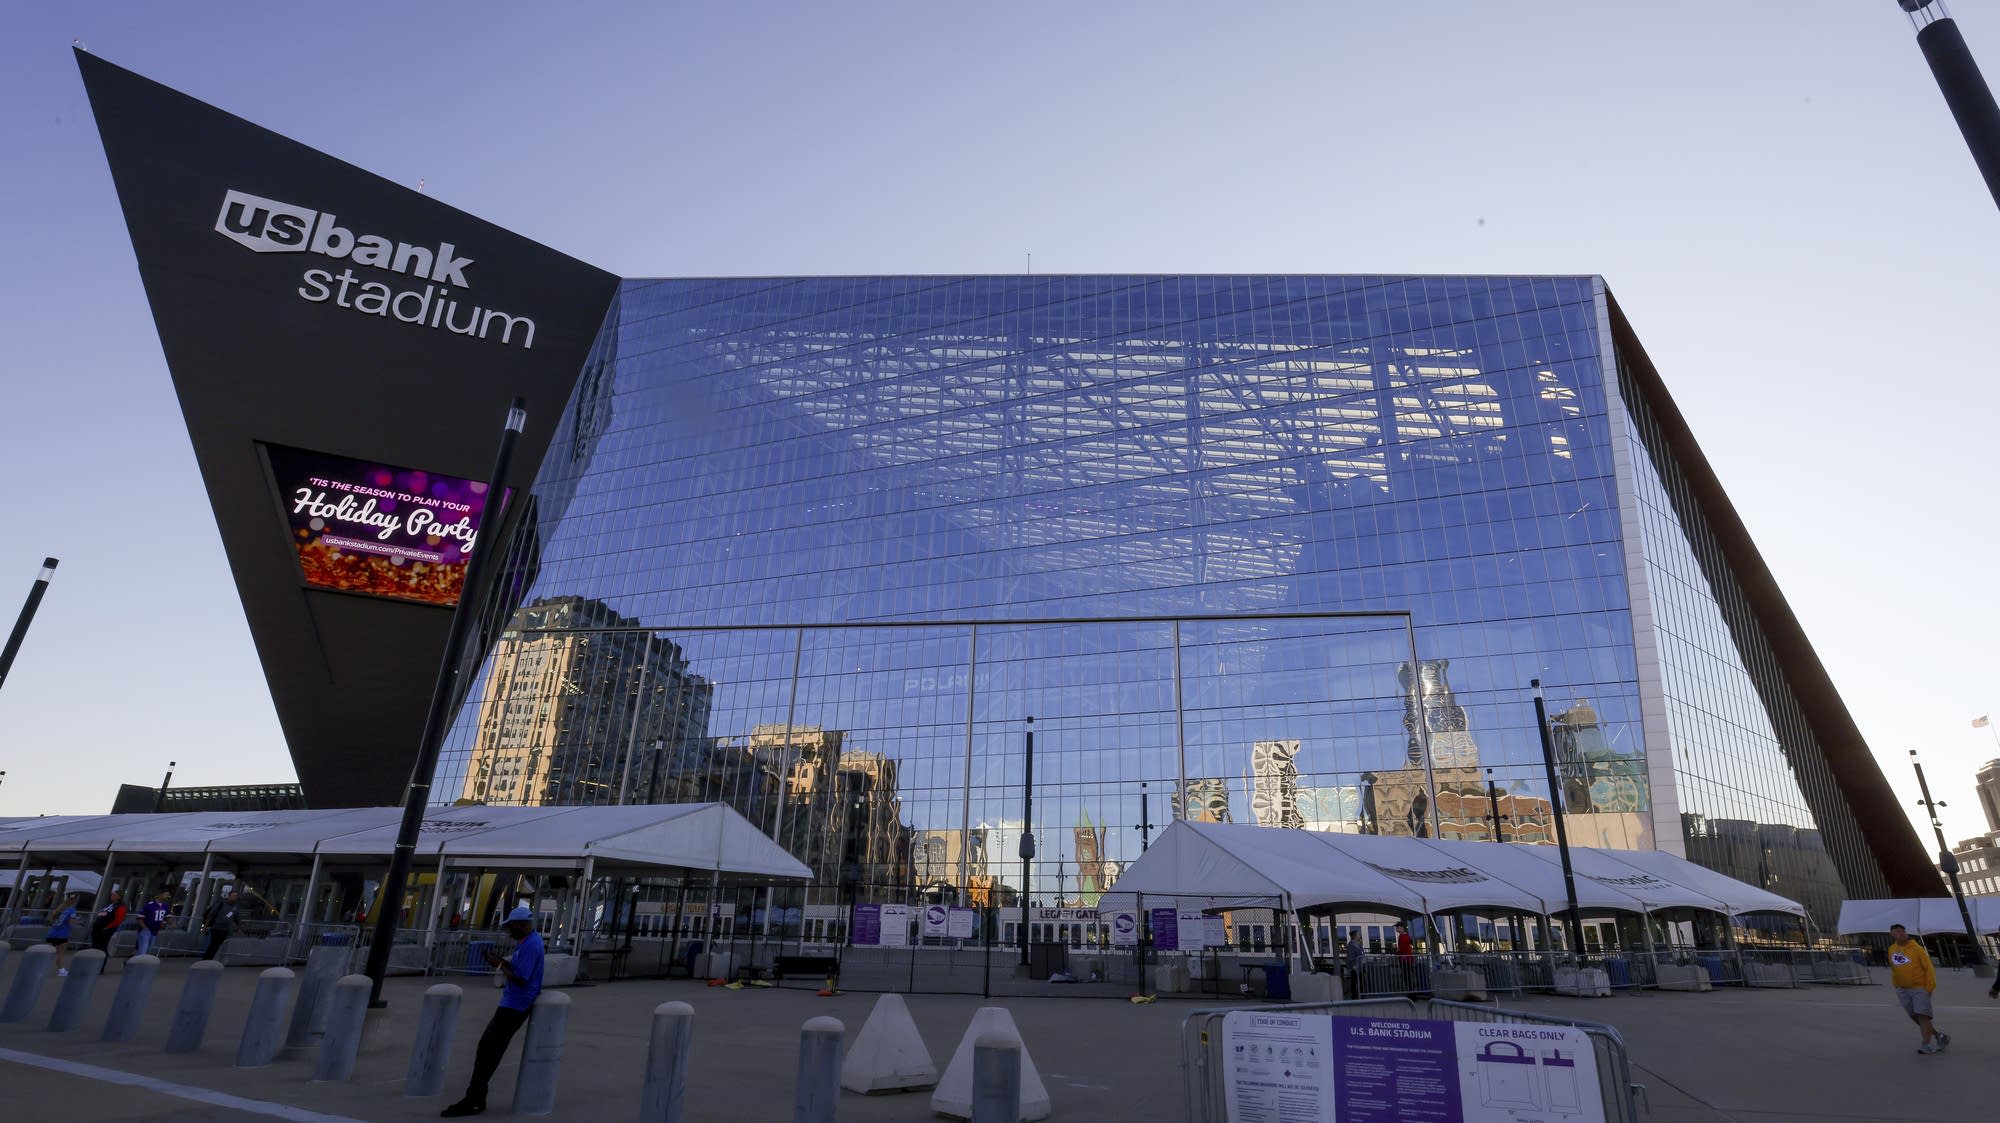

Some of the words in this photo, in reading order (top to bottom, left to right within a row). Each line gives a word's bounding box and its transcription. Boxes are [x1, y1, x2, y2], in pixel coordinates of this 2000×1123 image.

[298, 268, 537, 349] stadium
[330, 480, 352, 492] THE
[352, 485, 396, 500] SEASON
[397, 493, 412, 502] TO
[412, 495, 441, 508] PLAN
[441, 499, 471, 512] YOUR
[293, 487, 402, 540] Holiday
[406, 508, 478, 553] Party
[325, 536, 439, 561] usbankstadium.com/PrivateEvents
[154, 909, 165, 921] 18
[1076, 909, 1100, 920] GATE
[1370, 1021, 1400, 1030] WELCOME
[1350, 1027, 1367, 1037] U.S.
[1368, 1028, 1392, 1038] BANK
[1394, 1030, 1432, 1040] STADIUM
[1479, 1028, 1509, 1038] CLEAR
[1512, 1030, 1538, 1039] BAGS
[1539, 1031, 1565, 1041] ONLY
